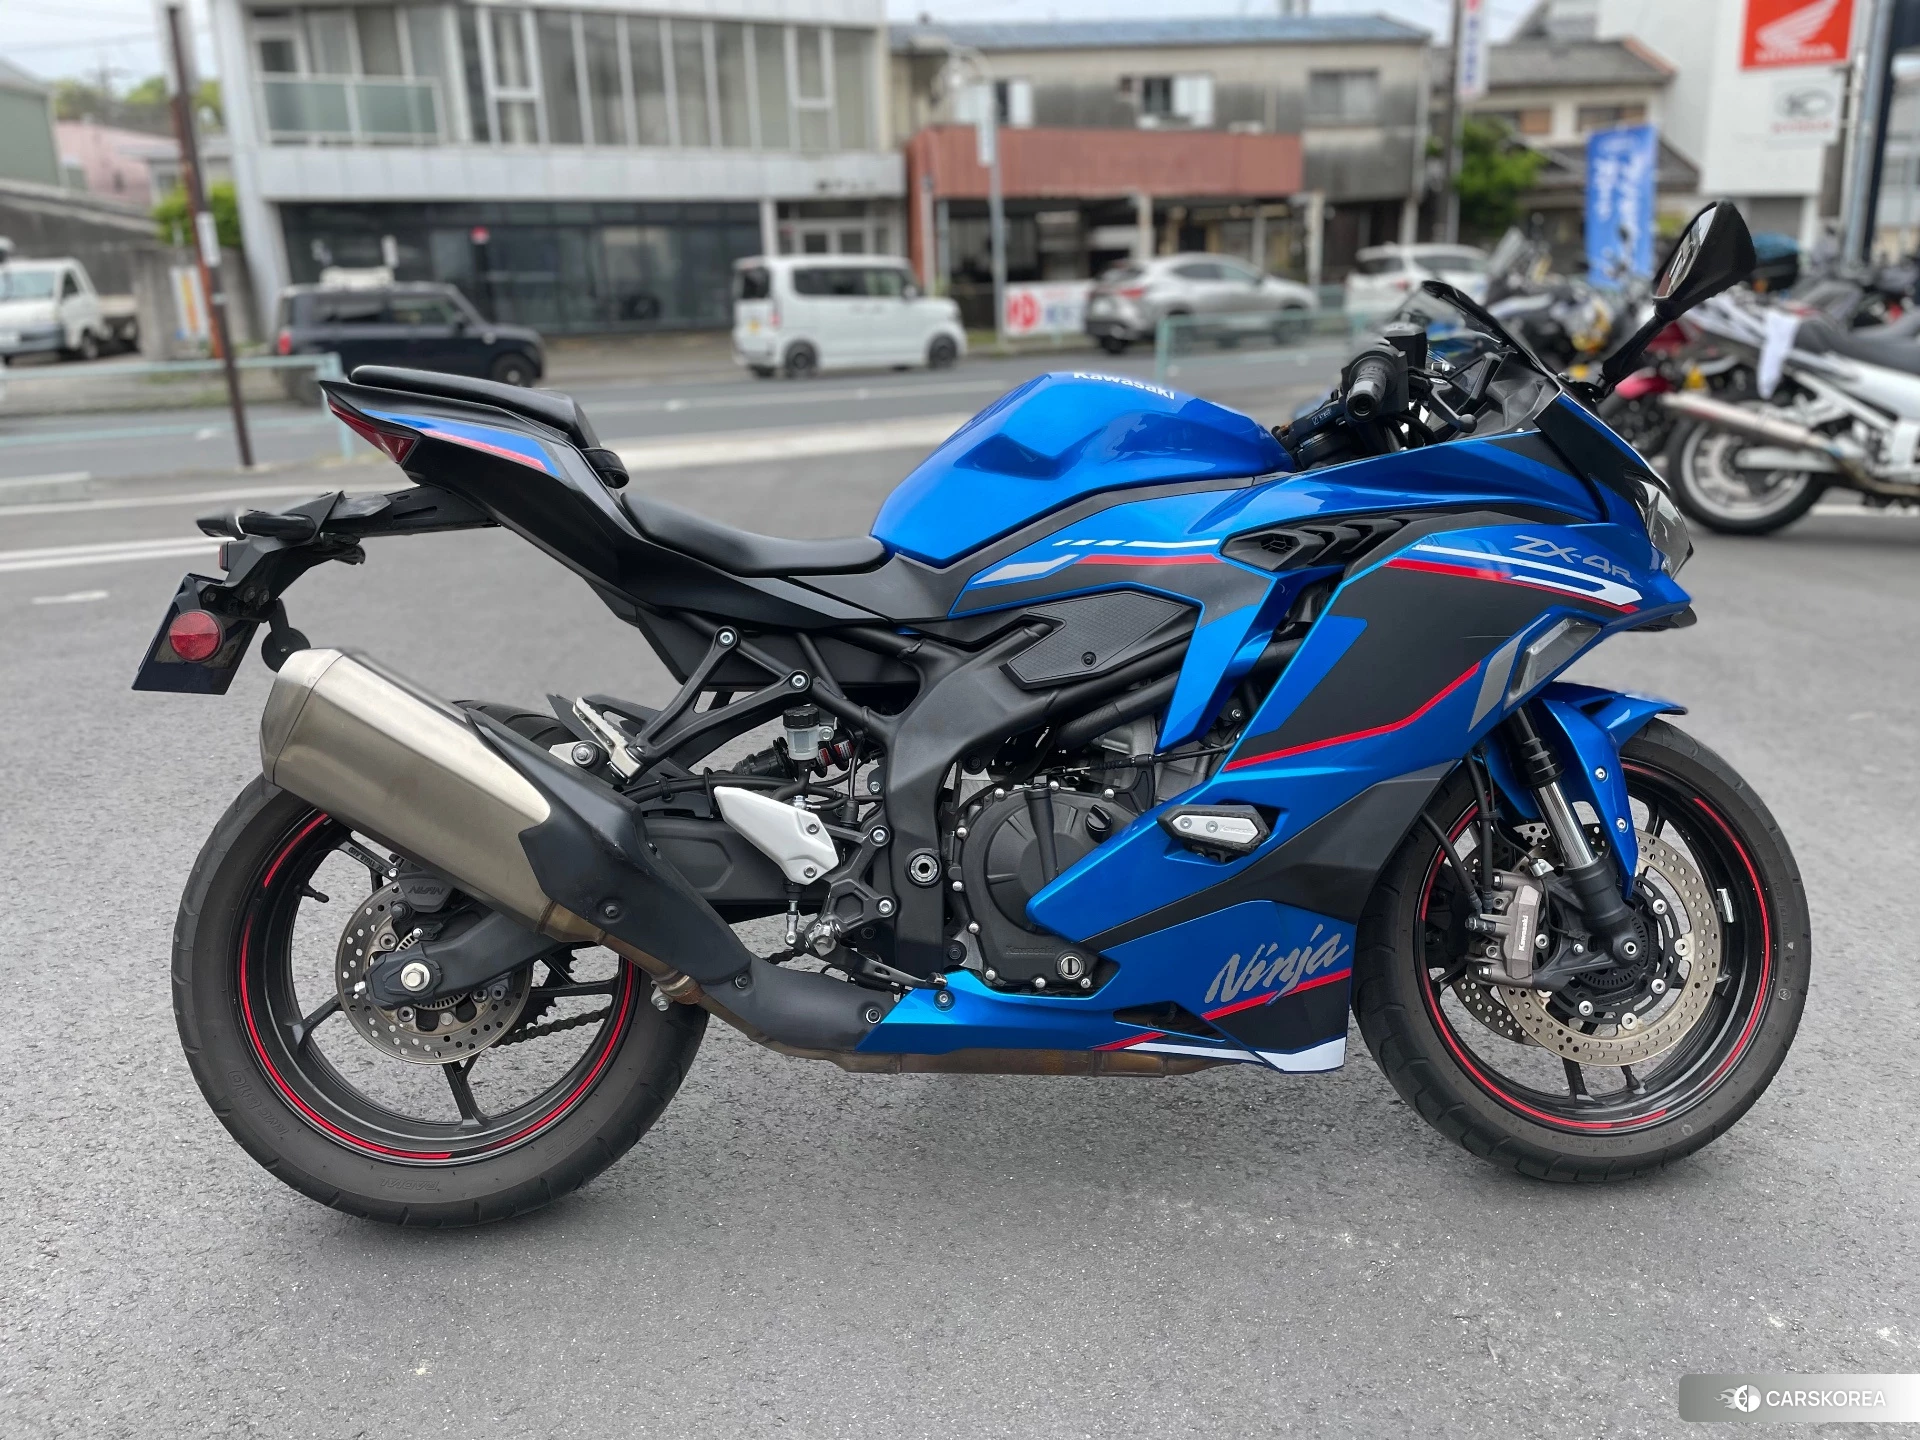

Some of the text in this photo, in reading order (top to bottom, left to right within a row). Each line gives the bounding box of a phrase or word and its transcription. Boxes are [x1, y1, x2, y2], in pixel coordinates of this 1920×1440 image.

[1073, 372, 1175, 400] Kawasaki
[1509, 534, 1643, 588] ZX-4R
[1518, 914, 1529, 952] Kawasaki
[1204, 923, 1350, 1006] Ninja
[380, 1177, 441, 1191] RADIAL
